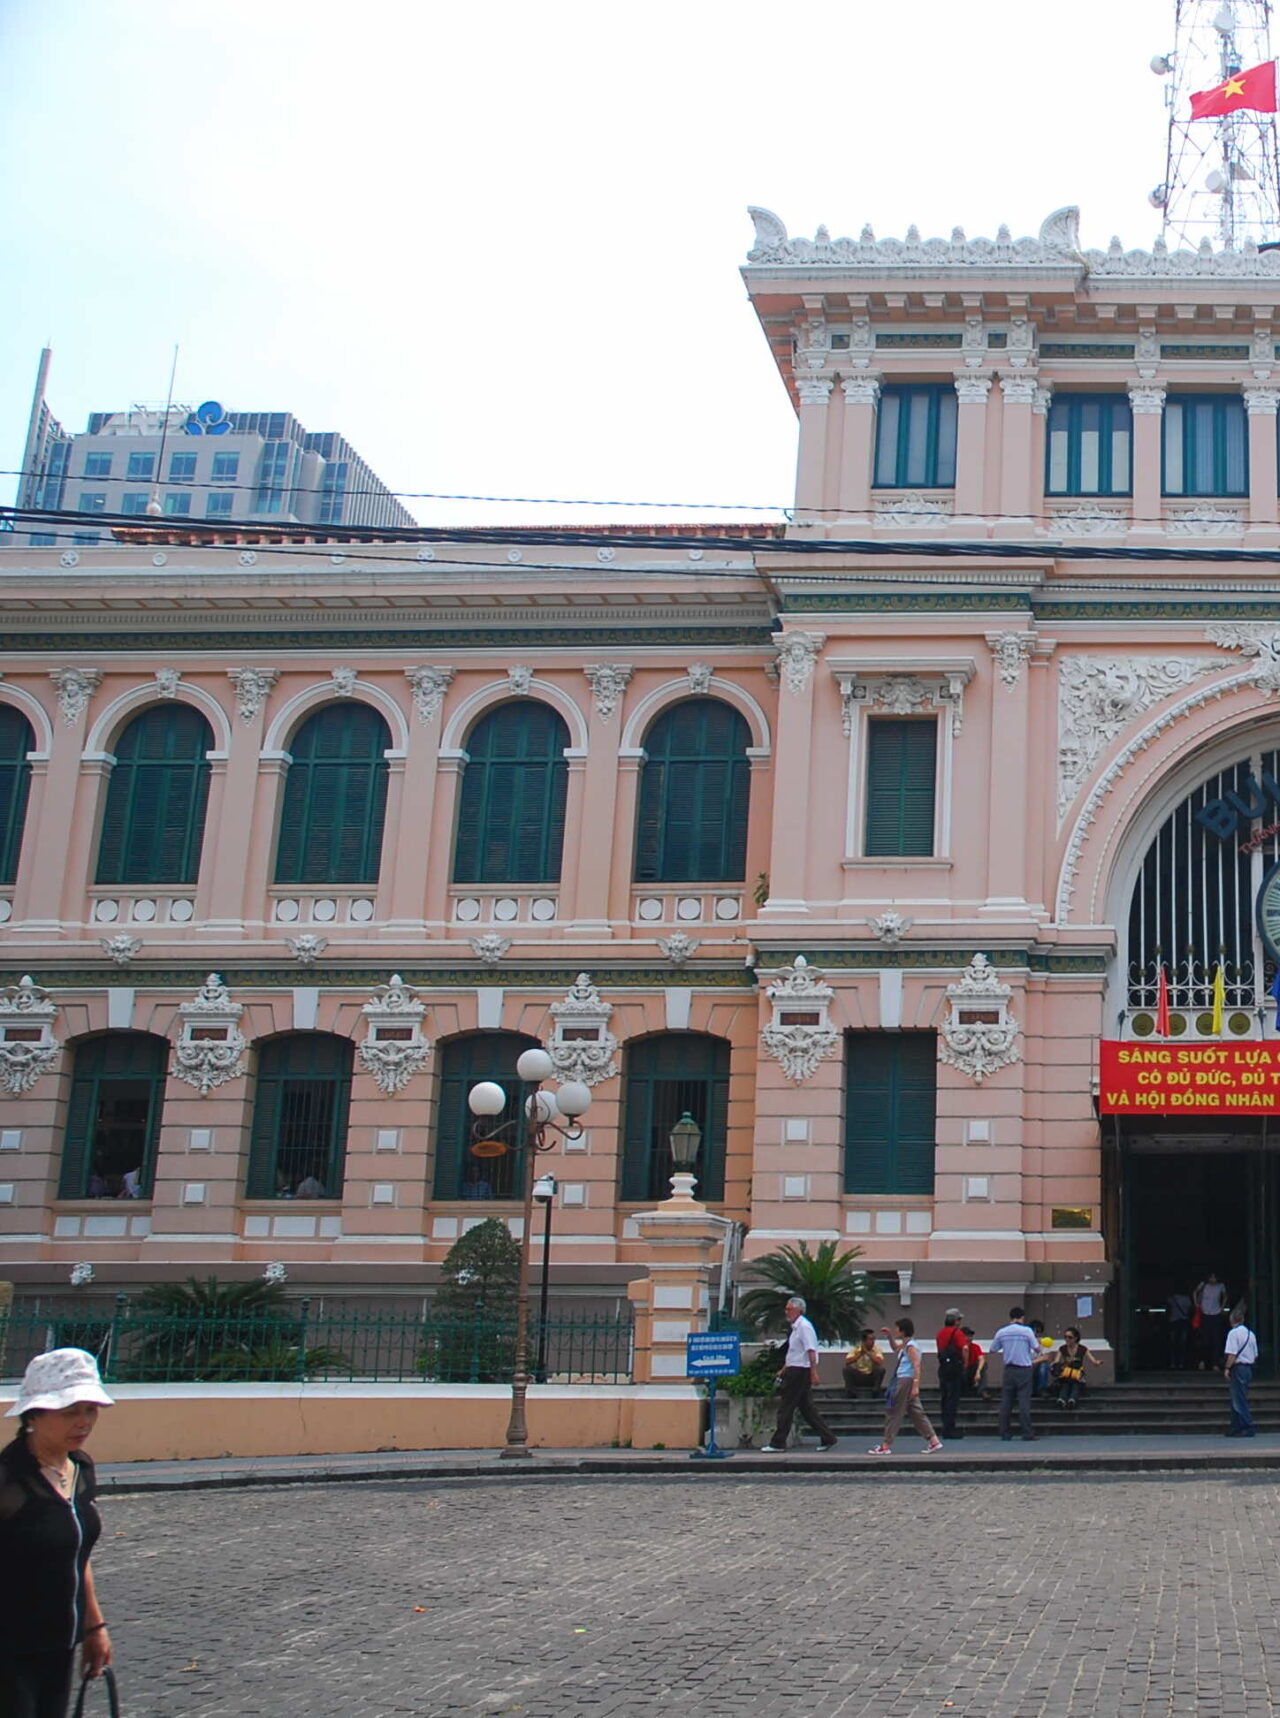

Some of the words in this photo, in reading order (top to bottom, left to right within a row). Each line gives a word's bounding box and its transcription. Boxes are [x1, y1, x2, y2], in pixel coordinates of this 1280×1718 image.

[1117, 1048, 1172, 1064] SÁNG
[1177, 1047, 1229, 1064] SUỐT
[1234, 1049, 1273, 1067] LỰA
[1137, 1068, 1163, 1085] CÓ
[1165, 1068, 1191, 1085] ĐỦ
[1194, 1069, 1236, 1088] ĐỨC,
[1240, 1068, 1266, 1085] ĐỦ
[1106, 1089, 1131, 1106] VÀ
[1134, 1090, 1166, 1109] HỘI
[1170, 1088, 1221, 1107] ĐỒNG
[1225, 1090, 1275, 1107] NHÂN
